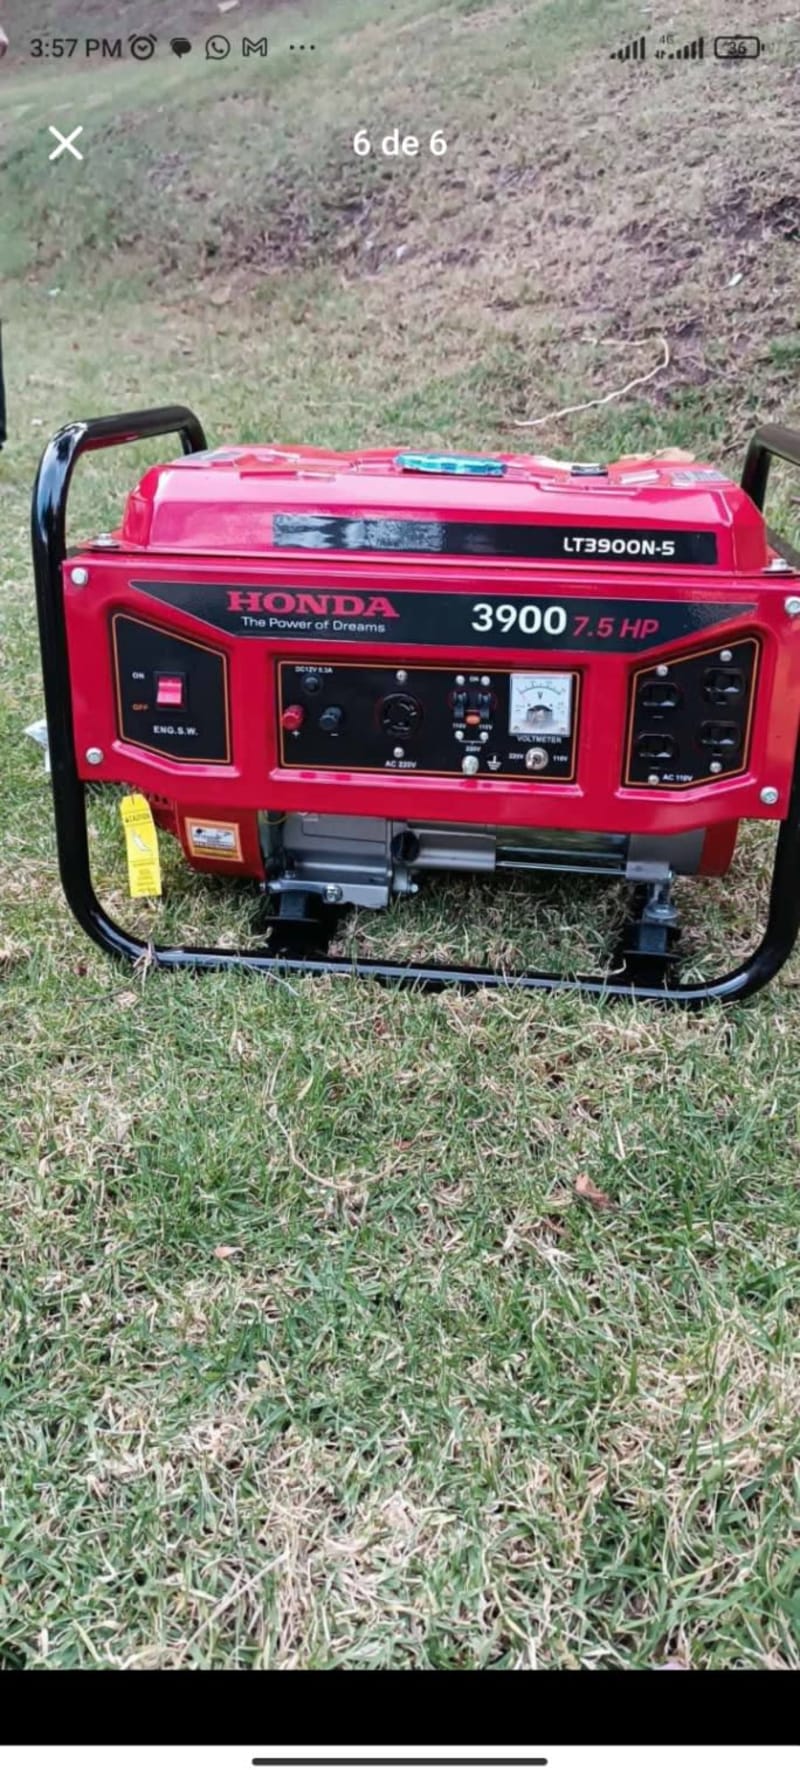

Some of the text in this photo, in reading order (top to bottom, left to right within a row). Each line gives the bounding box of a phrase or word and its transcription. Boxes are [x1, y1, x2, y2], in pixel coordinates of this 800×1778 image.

[563, 537, 675, 556] LT3900N-5
[226, 591, 400, 617] HONDA
[241, 616, 386, 633] The Power of Dreams
[471, 603, 660, 639] 3900 7.5 HP
[537, 691, 544, 700] V
[132, 703, 149, 711] OFF
[153, 725, 199, 736] ENG.S.W.
[517, 735, 562, 744] VOLTMETER
[385, 760, 397, 768] AC
[662, 773, 675, 781] AC
